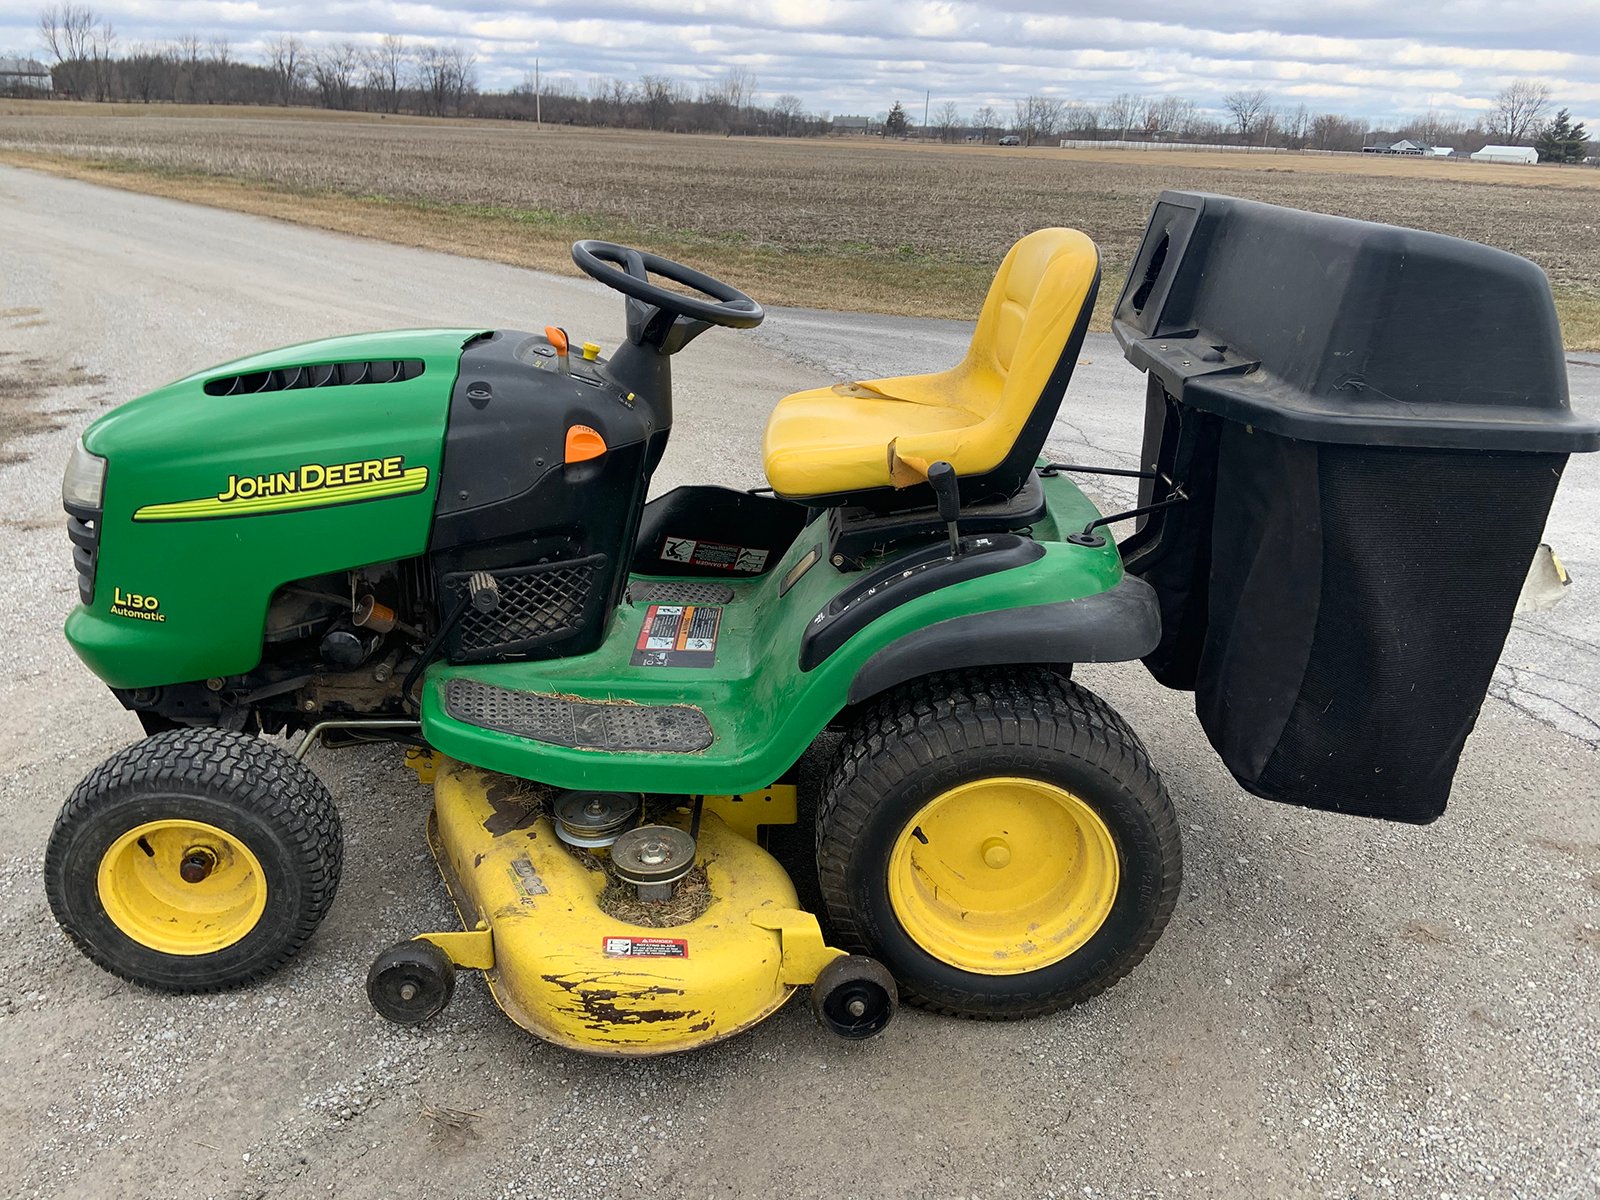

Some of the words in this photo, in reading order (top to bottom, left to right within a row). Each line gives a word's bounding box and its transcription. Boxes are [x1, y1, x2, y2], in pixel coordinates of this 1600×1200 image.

[217, 471, 297, 502] JOHN
[298, 455, 404, 490] DEERE
[114, 586, 160, 611] L130
[110, 604, 166, 623] Automatic
